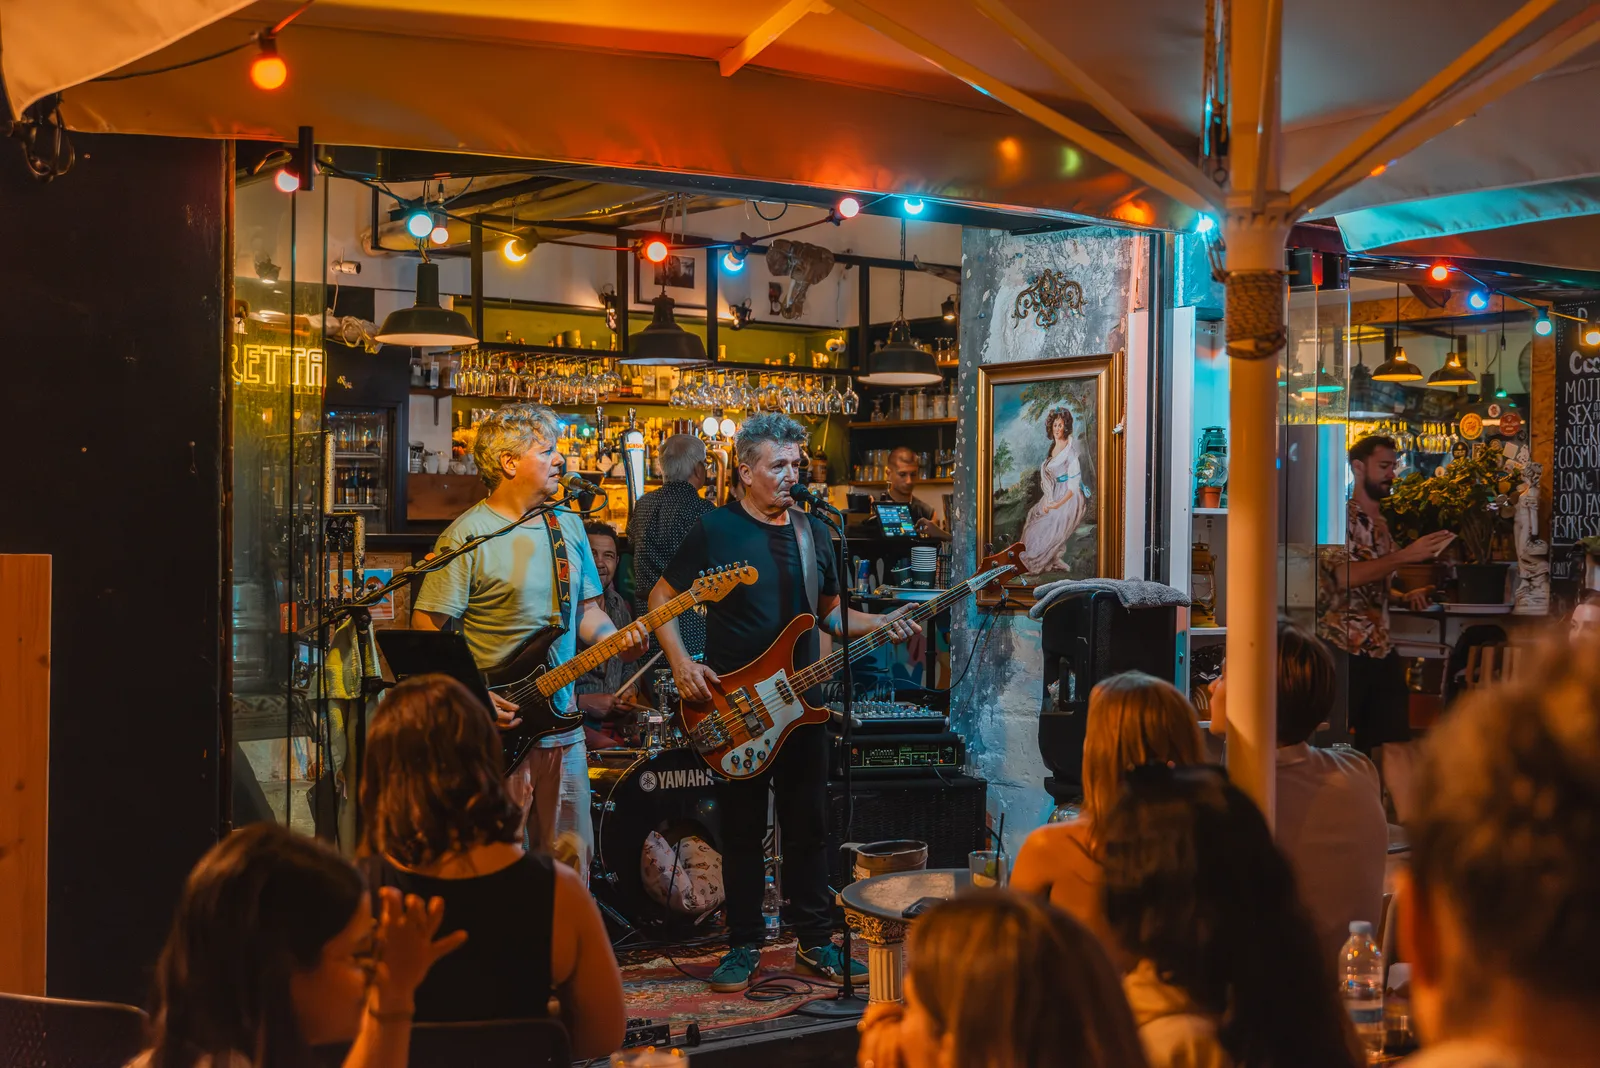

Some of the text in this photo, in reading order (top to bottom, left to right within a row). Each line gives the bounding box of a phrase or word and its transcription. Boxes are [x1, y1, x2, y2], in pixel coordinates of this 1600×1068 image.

[1568, 403, 1593, 425] SEX
[1560, 470, 1593, 492] LONG
[1559, 493, 1582, 515] OLD
[657, 767, 715, 790] YAMAHA
